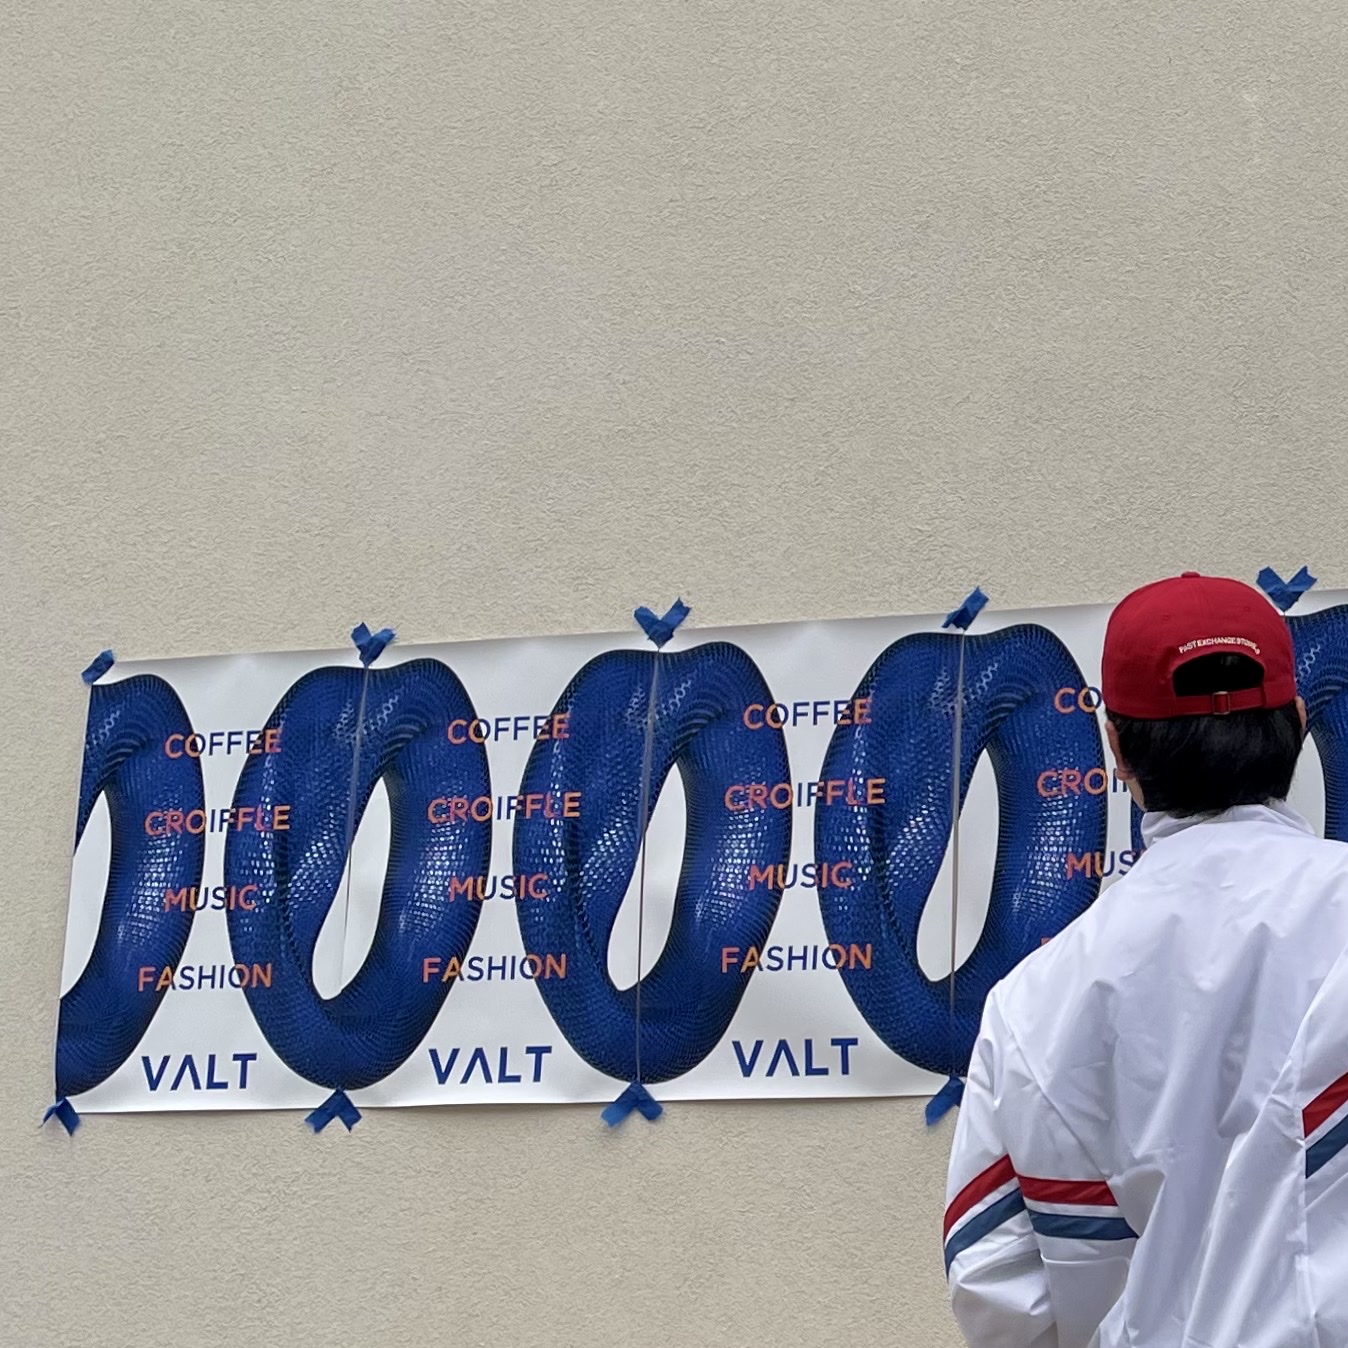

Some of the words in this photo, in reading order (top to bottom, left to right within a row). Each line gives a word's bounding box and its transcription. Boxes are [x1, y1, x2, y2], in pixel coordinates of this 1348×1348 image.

[447, 713, 571, 744] COFFEE
[743, 698, 872, 730] COFFEE
[165, 729, 283, 758] COFFEE
[724, 778, 886, 812] CROIFFLE
[1036, 767, 1128, 799] CROI
[145, 805, 291, 836] CROIFFLE
[428, 791, 582, 824] CROIFFLE
[748, 861, 853, 891] MUSIC
[1065, 850, 1134, 881] MUS
[164, 884, 258, 913] MUSIC
[448, 873, 549, 902] MUSIC
[422, 954, 567, 983] FASHION
[721, 944, 872, 974] FASHION
[138, 963, 272, 992] FASHION
[141, 1053, 257, 1092] VALT
[428, 1046, 552, 1085] VALT
[732, 1038, 858, 1078] VALT
